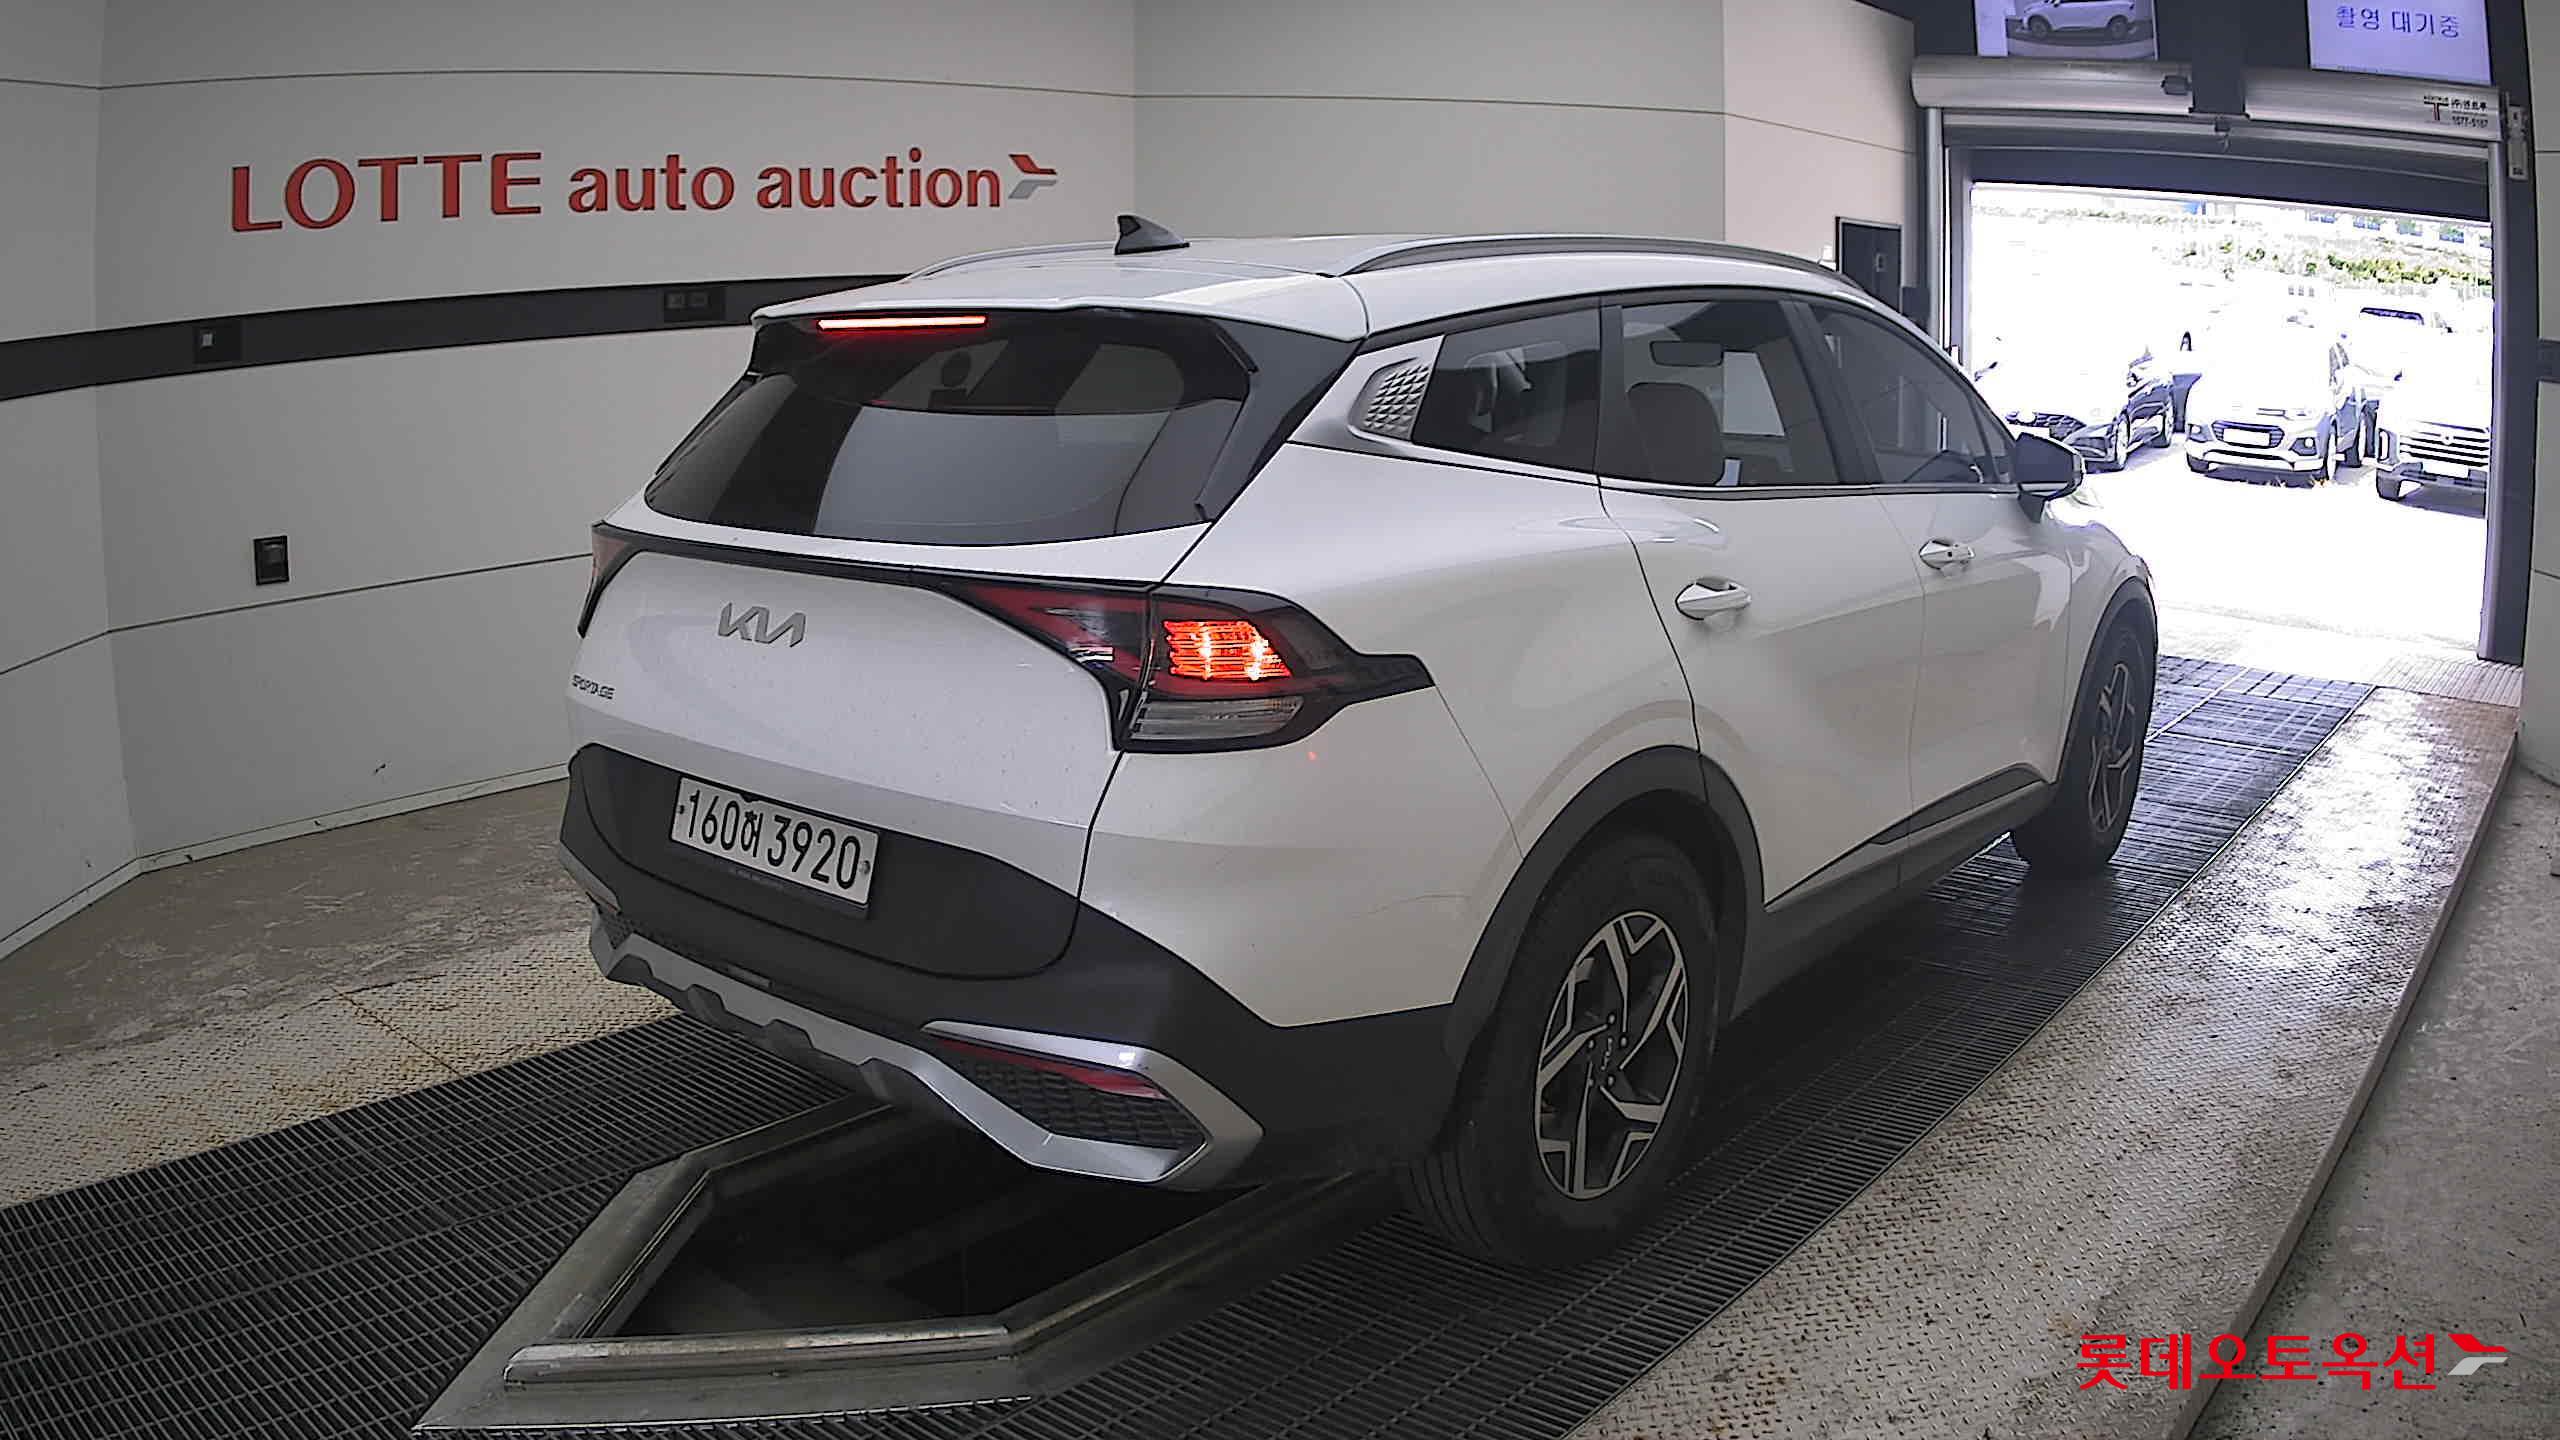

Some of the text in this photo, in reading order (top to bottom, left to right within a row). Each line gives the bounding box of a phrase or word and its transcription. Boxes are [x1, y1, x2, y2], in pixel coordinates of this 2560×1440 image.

[2336, 5, 2460, 38] 촬영 대기중
[231, 147, 1002, 233] LOTTE auto auction
